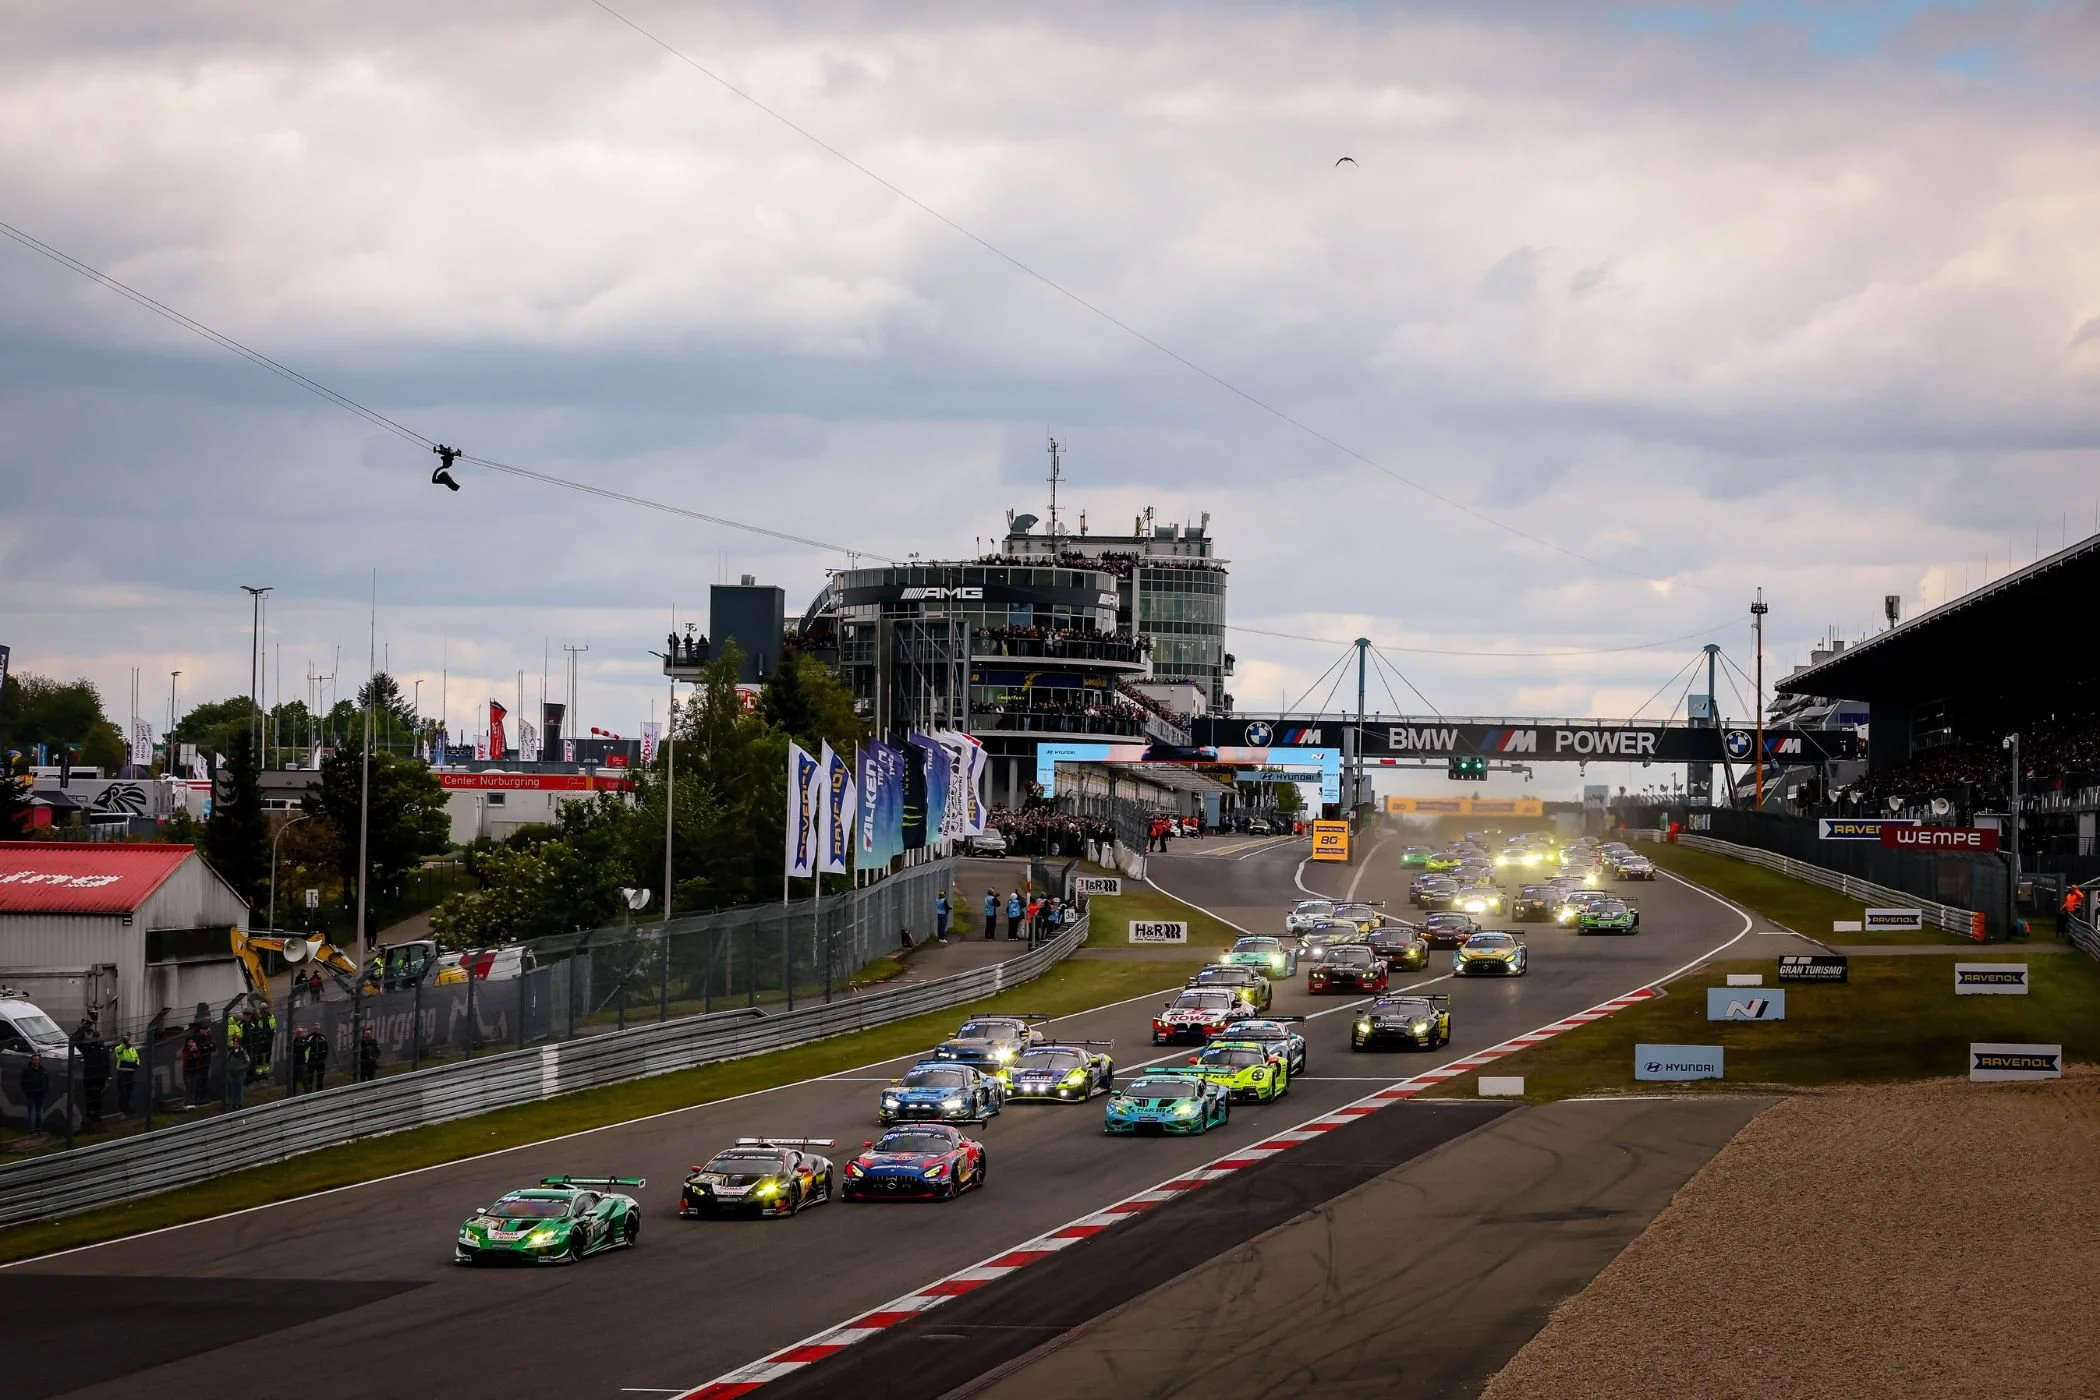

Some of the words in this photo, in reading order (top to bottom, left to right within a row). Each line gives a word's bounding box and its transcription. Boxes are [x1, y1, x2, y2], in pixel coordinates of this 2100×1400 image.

[923, 587, 983, 599] AMG
[1388, 727, 1458, 750] BMW
[1555, 730, 1656, 754] POWER
[1276, 772, 1315, 781] HYUNDAI
[444, 775, 476, 785] Center
[480, 775, 540, 789] Nürburgring
[1897, 830, 1981, 846] WEMPE
[1780, 965, 1804, 975] GRAN
[1805, 965, 1843, 975] TURISMO
[1964, 974, 2020, 982] RAVENOL
[1169, 1014, 1212, 1022] ROWE
[1981, 1057, 2051, 1067] RAVENOL
[1665, 1062, 1715, 1073] HYUNDAI
